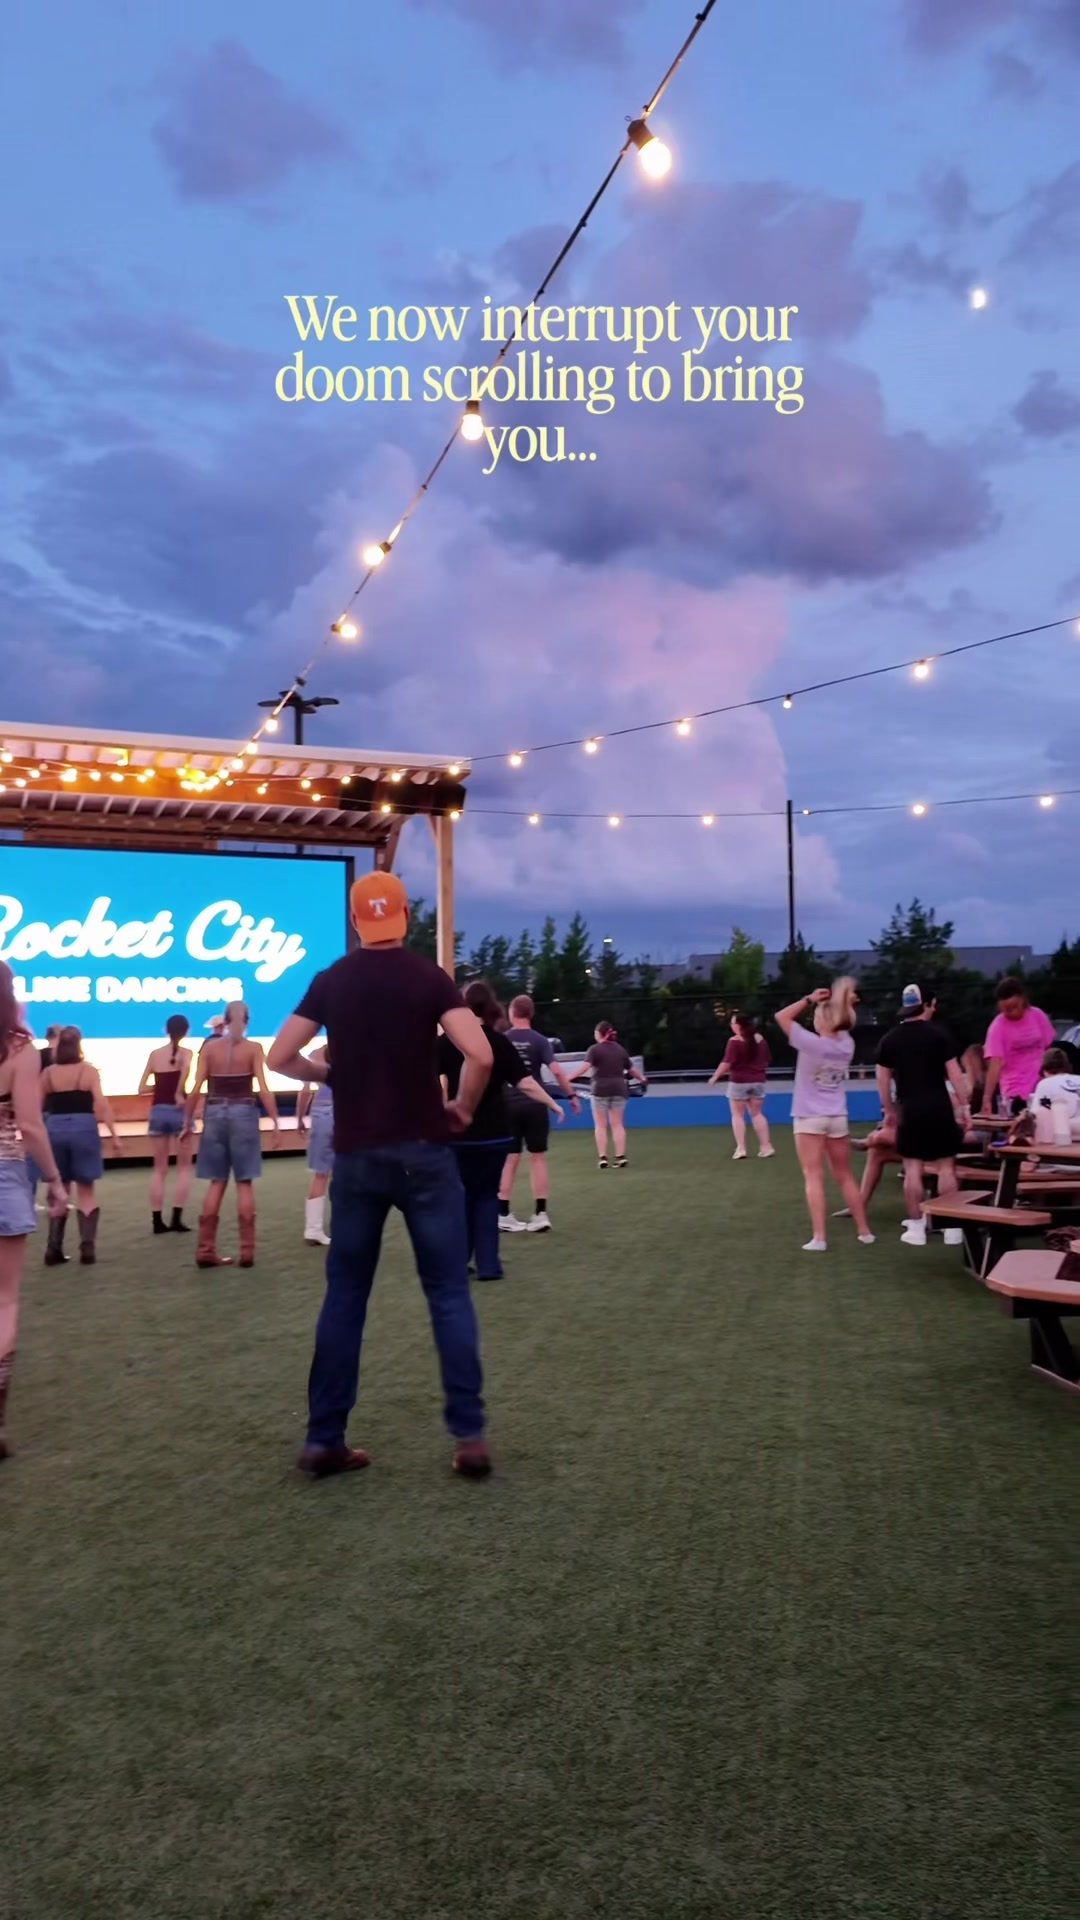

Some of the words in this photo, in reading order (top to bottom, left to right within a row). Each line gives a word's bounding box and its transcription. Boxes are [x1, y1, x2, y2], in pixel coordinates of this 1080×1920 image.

[367, 896, 388, 919] T
[186, 899, 306, 982] City
[12, 975, 91, 1003] LINE
[95, 976, 244, 1003] DANCING
